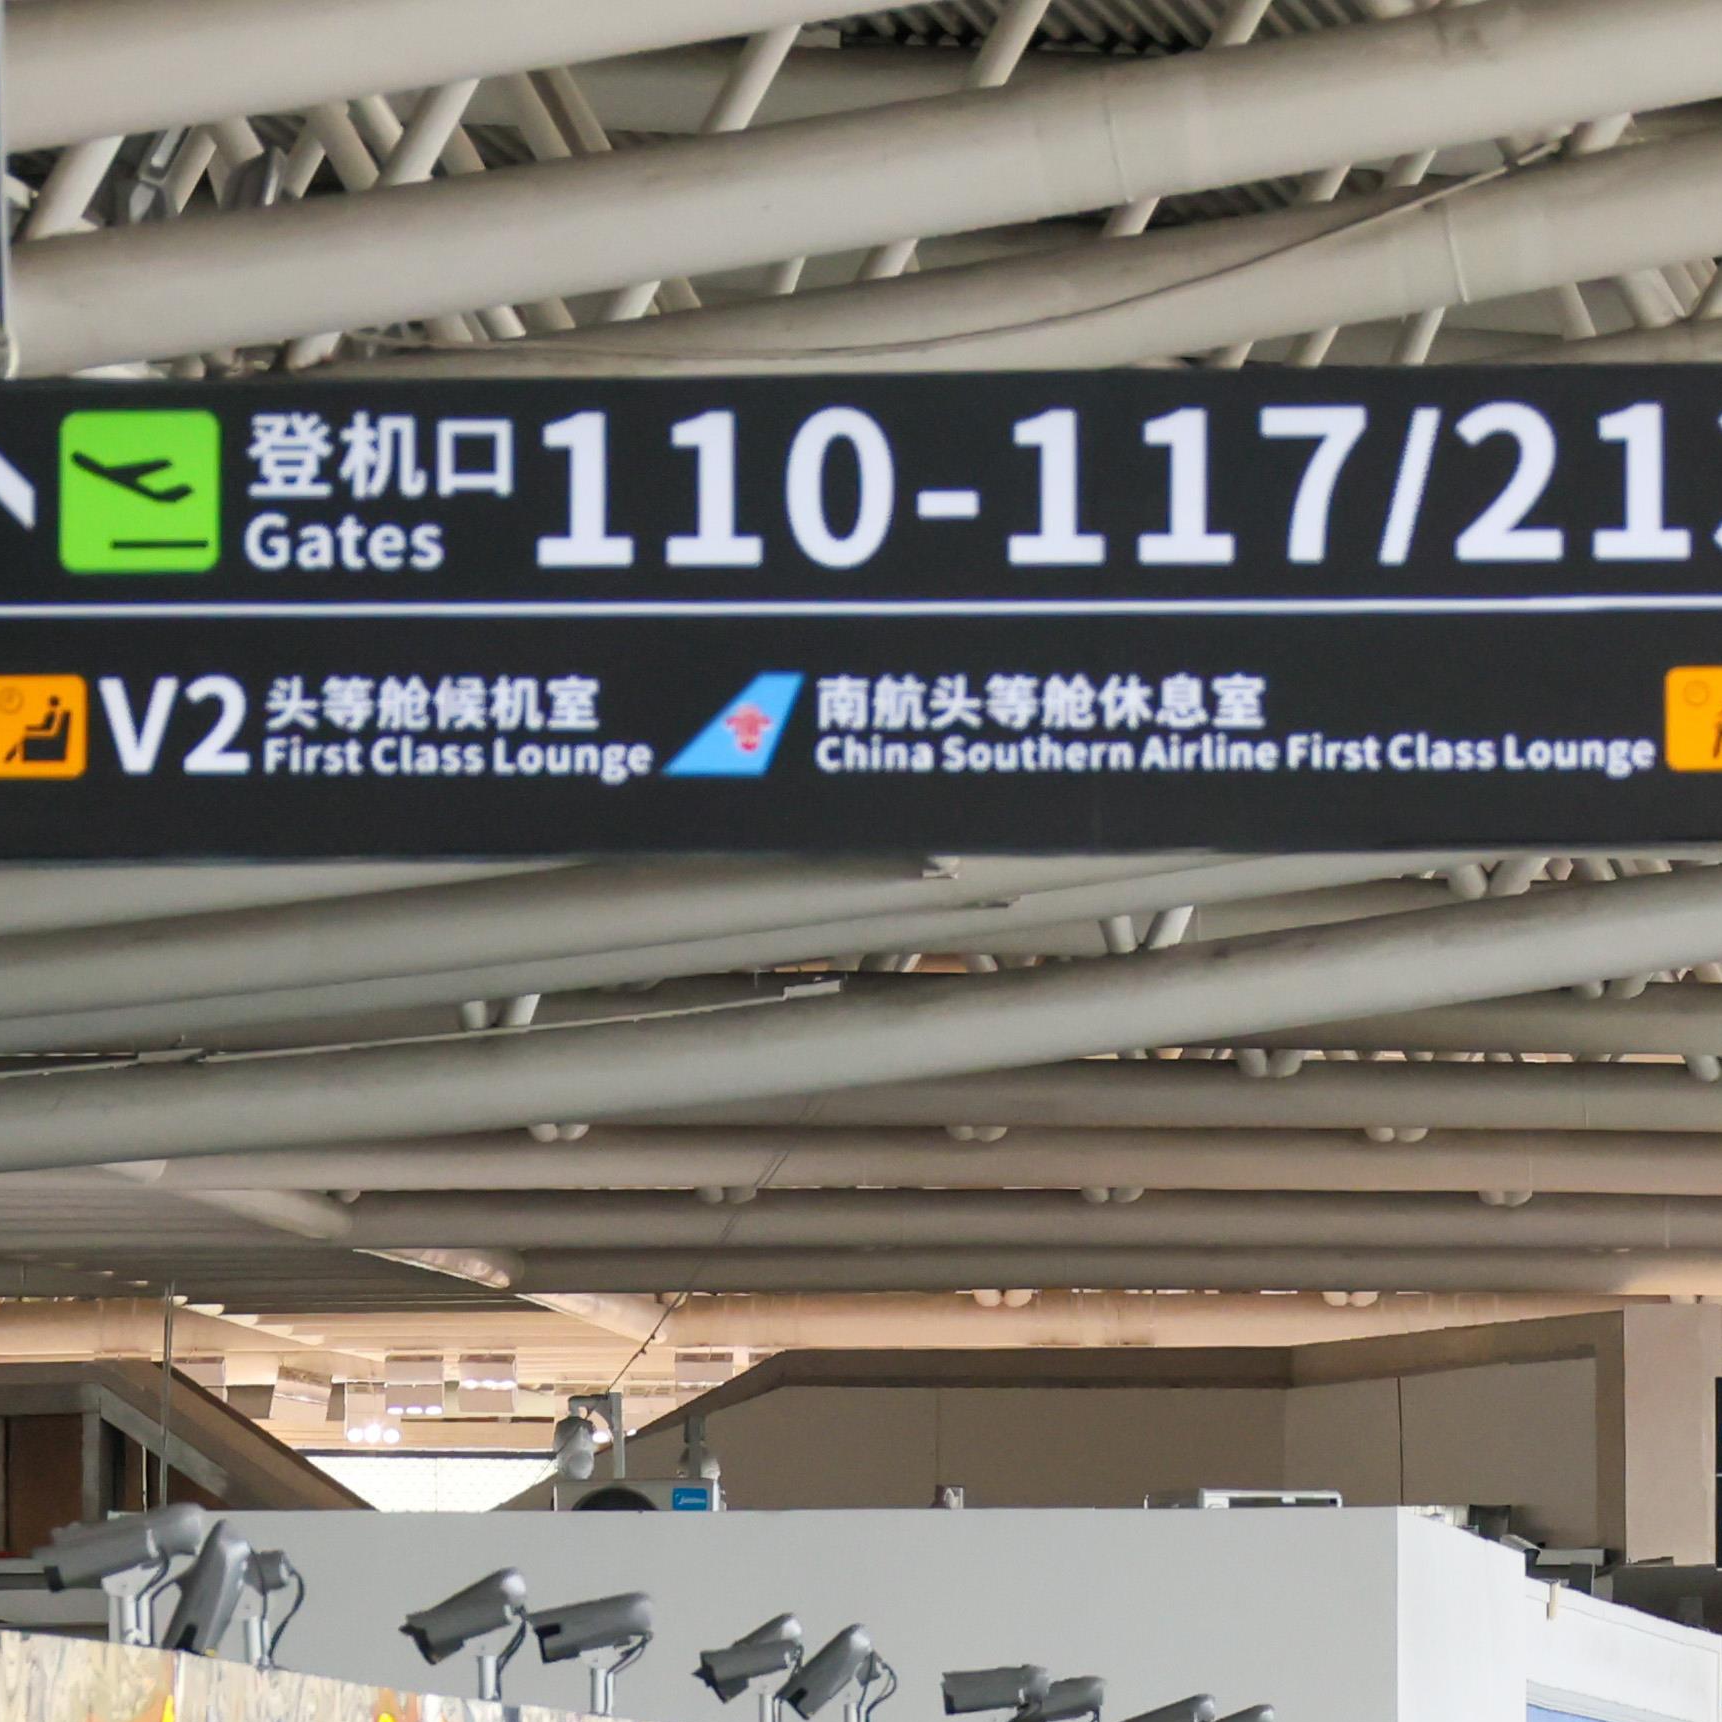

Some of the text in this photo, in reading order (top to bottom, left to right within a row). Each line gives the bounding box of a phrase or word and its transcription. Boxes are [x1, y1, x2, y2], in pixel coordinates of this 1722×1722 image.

[248, 411, 513, 499] 登机口
[245, 513, 444, 570] Gates
[99, 675, 250, 774] V2
[266, 675, 600, 731] 头等舱候机室
[816, 673, 1266, 730] 南航头等舱休息室
[264, 735, 653, 784] First Class Lounge
[816, 732, 1656, 778] China Southern Airline First Class Lounge
